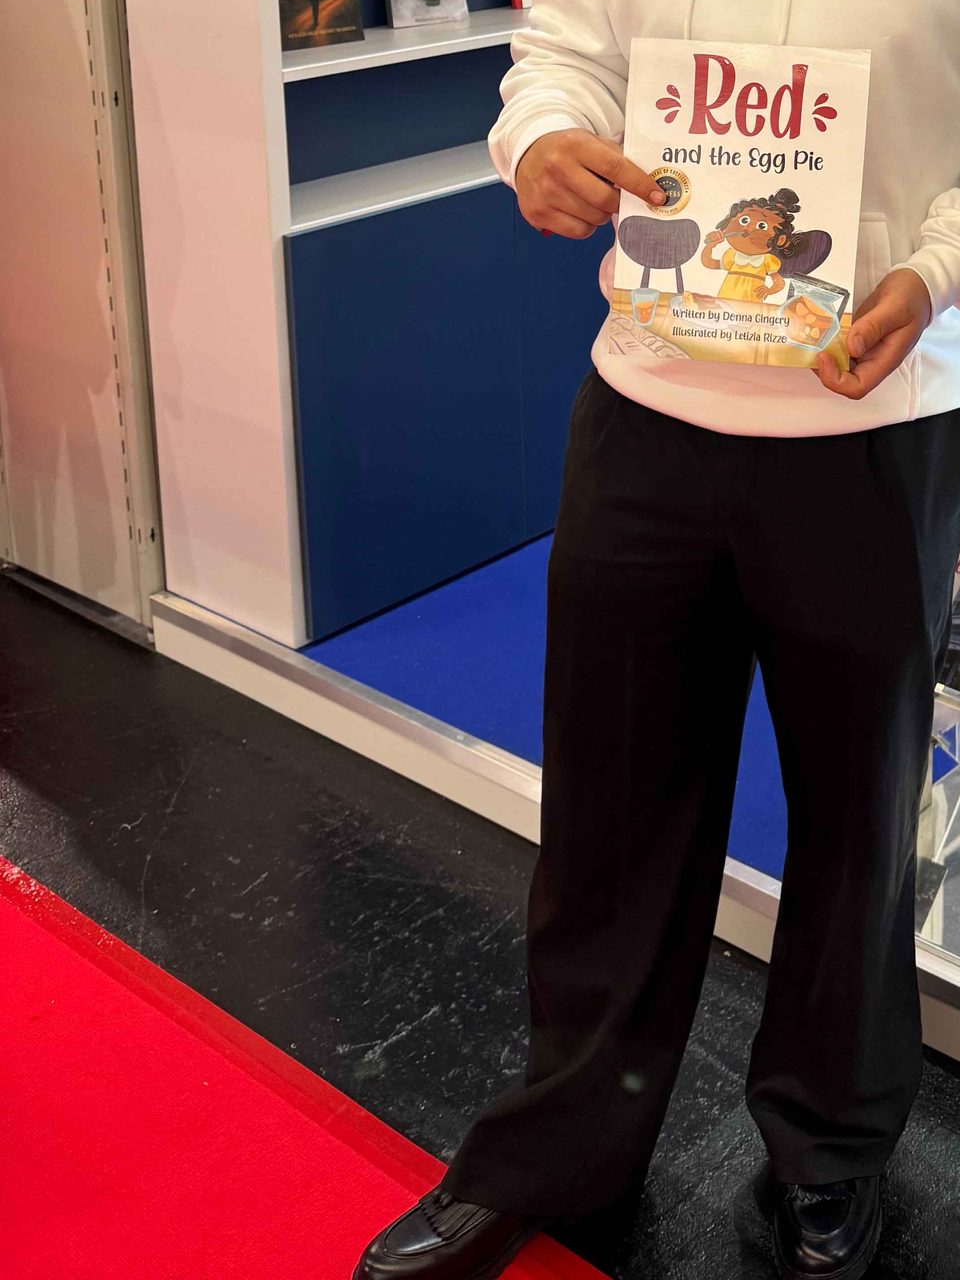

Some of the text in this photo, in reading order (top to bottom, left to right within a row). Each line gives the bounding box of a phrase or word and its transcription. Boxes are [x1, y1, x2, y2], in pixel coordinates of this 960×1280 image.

[688, 53, 809, 140] Red
[661, 145, 825, 174] and the Egg Pie
[672, 308, 706, 320] Written
[707, 310, 721, 323] by
[755, 313, 790, 327] Gingery
[672, 326, 718, 339] Illustrated
[720, 329, 732, 341] by
[734, 330, 761, 342] Letizia
